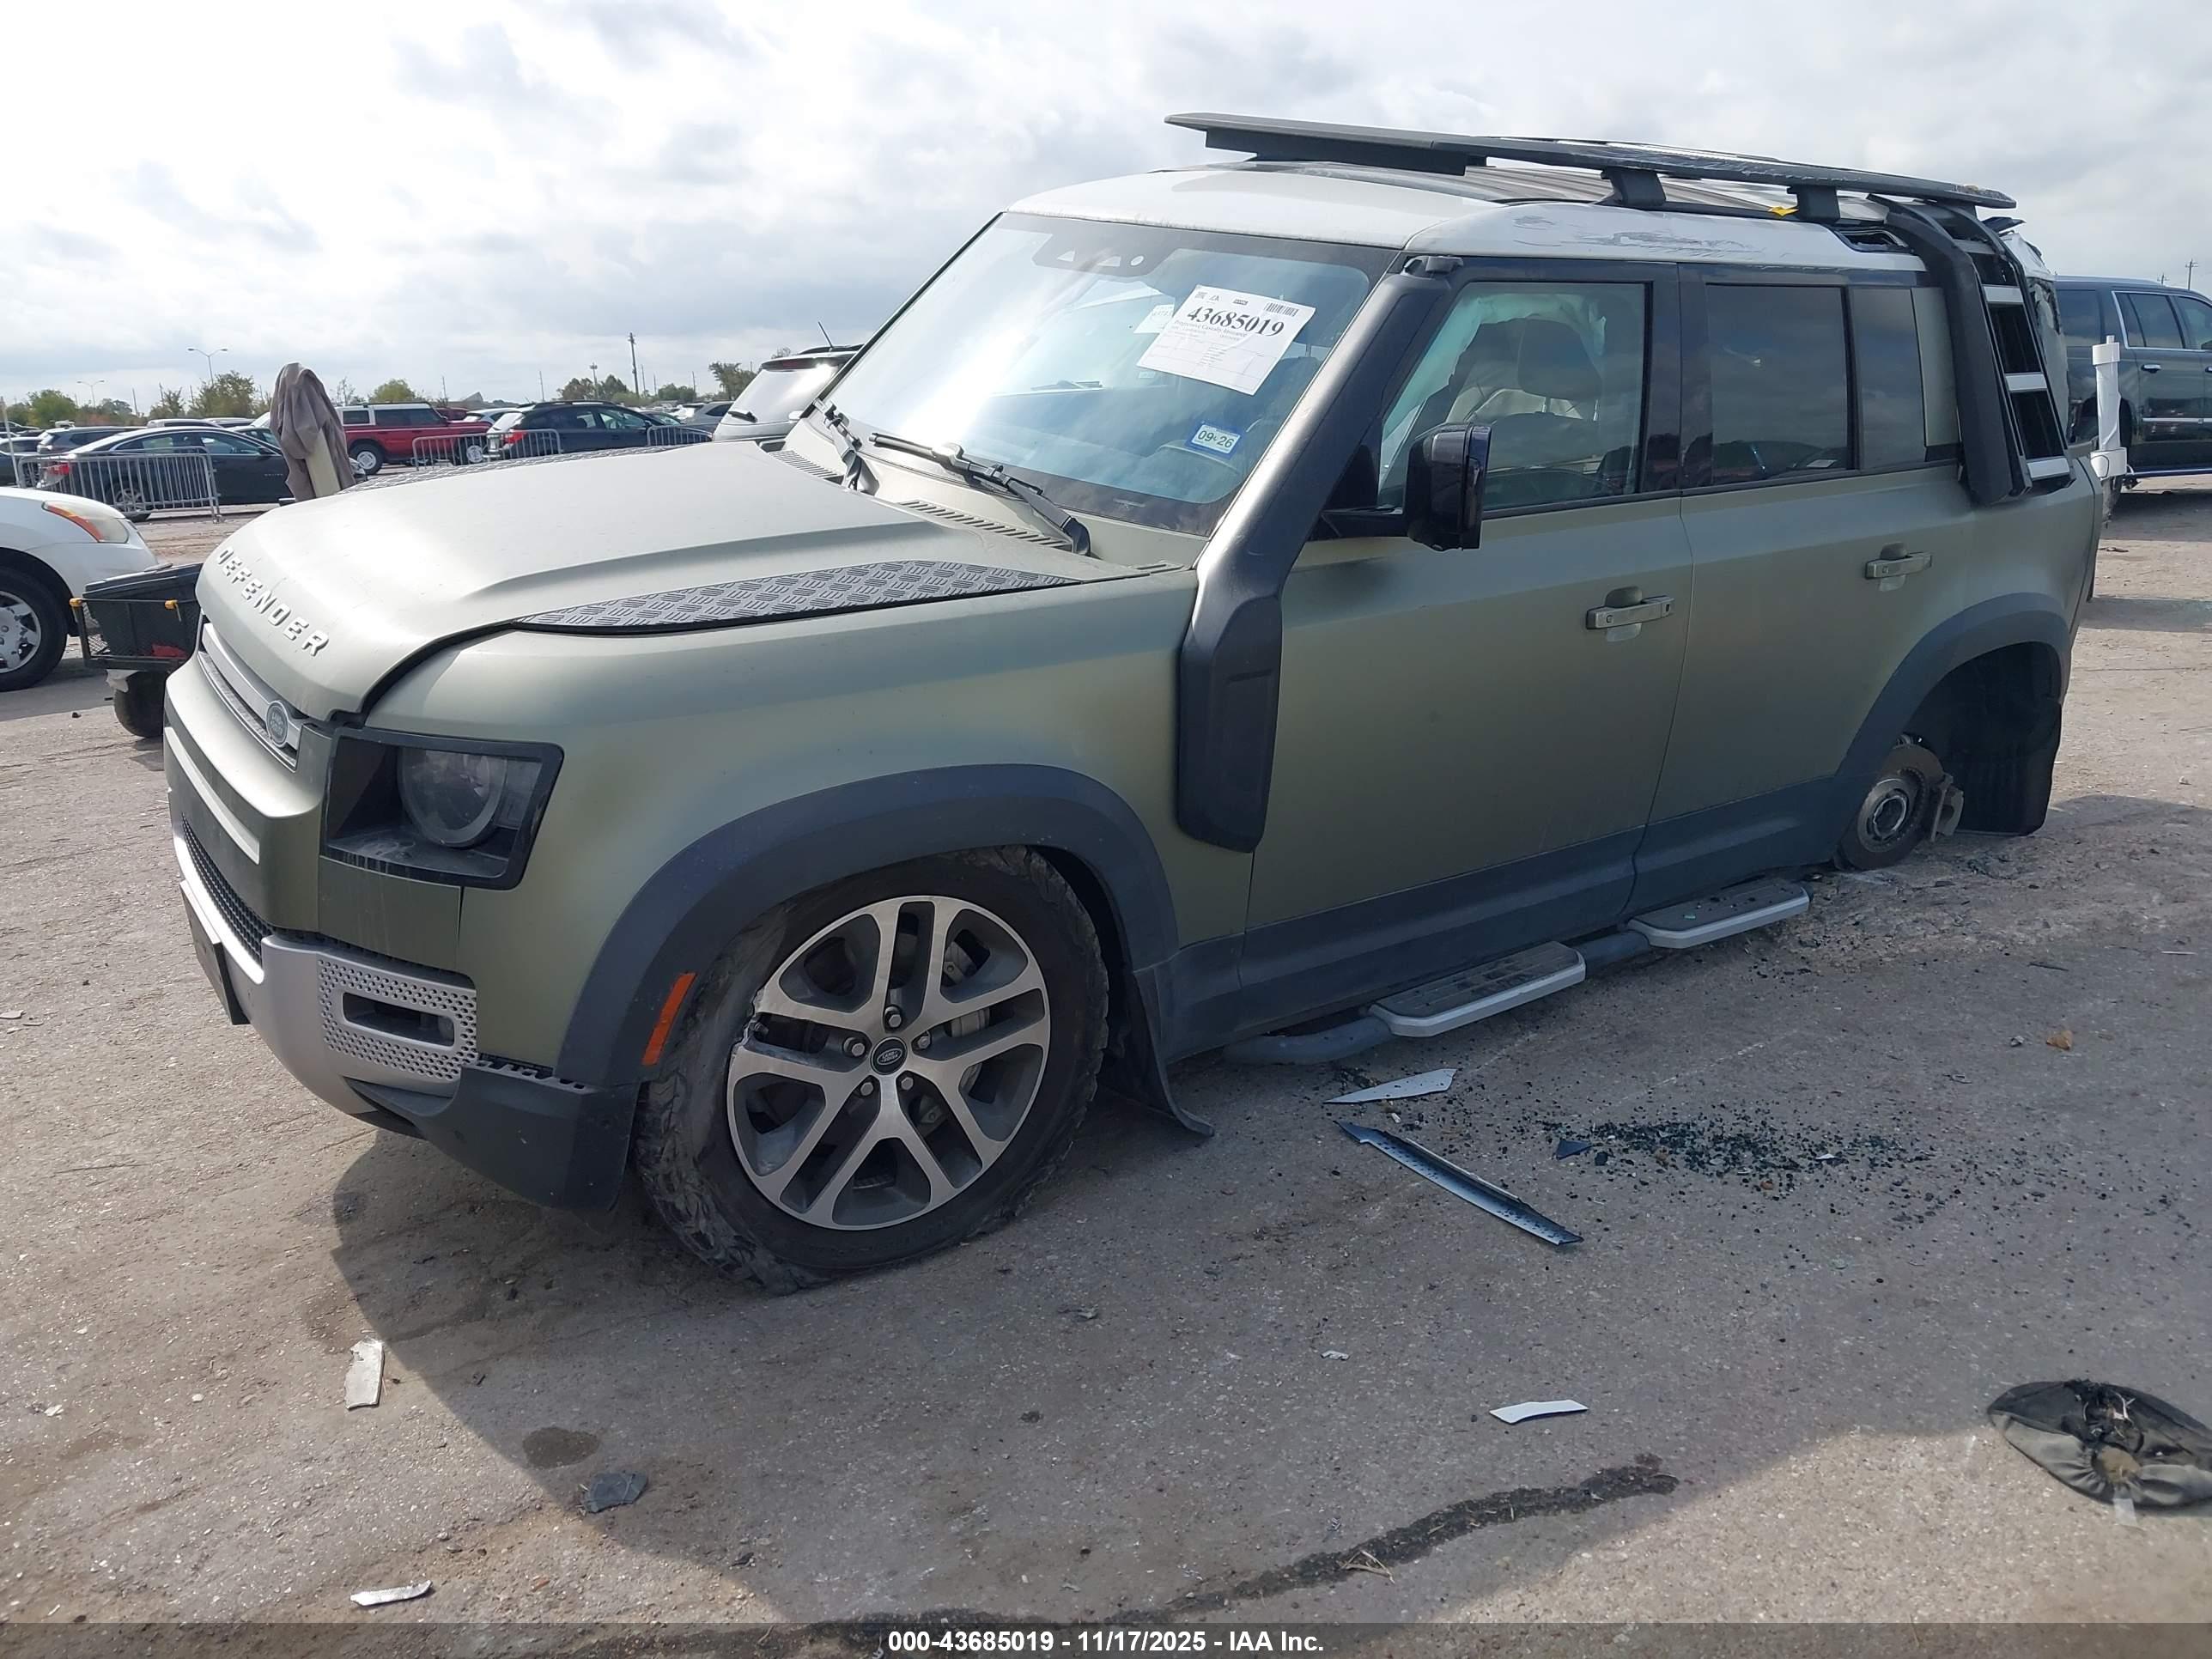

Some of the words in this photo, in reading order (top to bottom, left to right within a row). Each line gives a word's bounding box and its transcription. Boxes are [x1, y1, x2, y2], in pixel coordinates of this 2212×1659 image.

[1187, 306, 1285, 337] 43685019
[1198, 430, 1214, 442] 09
[1217, 435, 1235, 448] 26
[217, 546, 329, 657] DEFENDER
